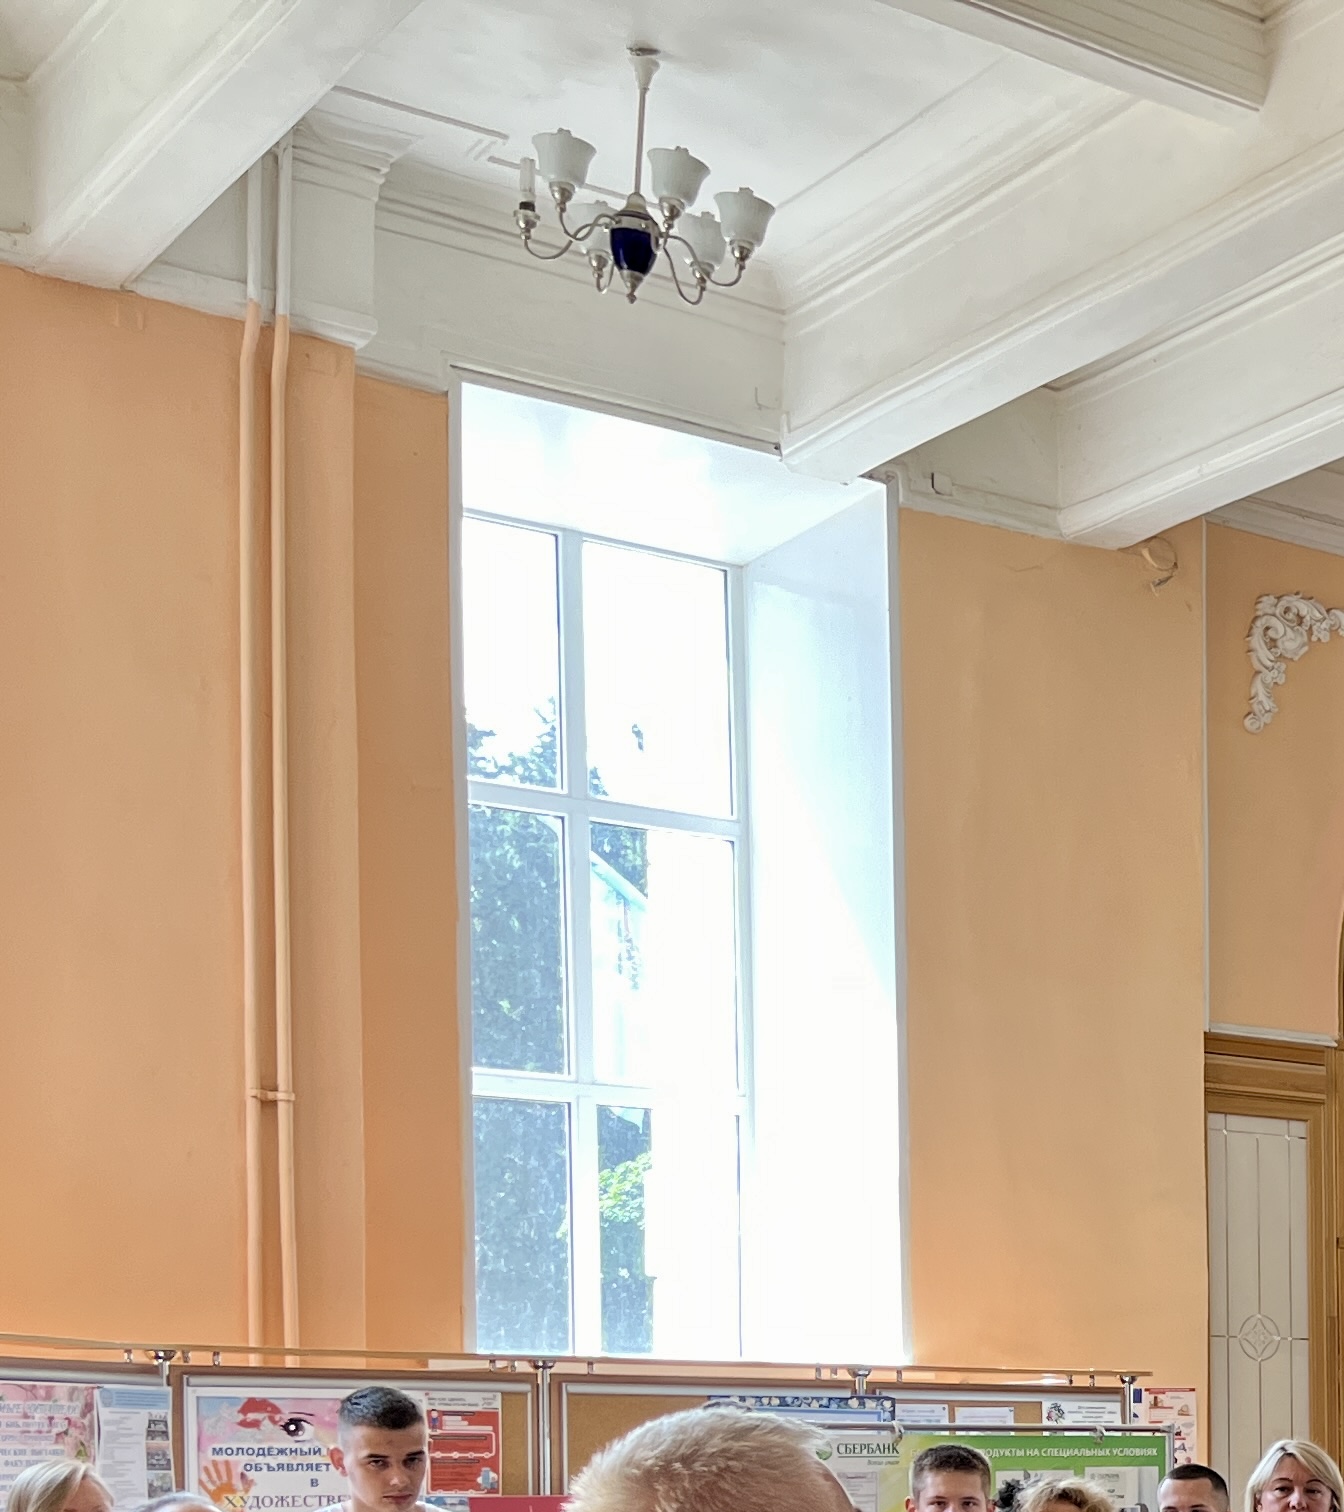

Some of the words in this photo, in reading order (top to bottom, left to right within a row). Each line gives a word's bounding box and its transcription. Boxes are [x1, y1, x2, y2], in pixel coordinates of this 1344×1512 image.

[836, 1442, 900, 1455] СБЕРБАНК
[980, 1448, 1025, 1458] РОДУКТЫ
[1026, 1448, 1040, 1457] НА
[1041, 1447, 1111, 1458] СПЕЦИАЛЬНЫХ
[1112, 1447, 1158, 1457] УСЛОВИЯХ
[243, 1463, 332, 1473] ОБЪЯВЛЯЕТ
[310, 1478, 320, 1488] В
[225, 1495, 351, 1511] ХУДОЖЕСТВЕ
